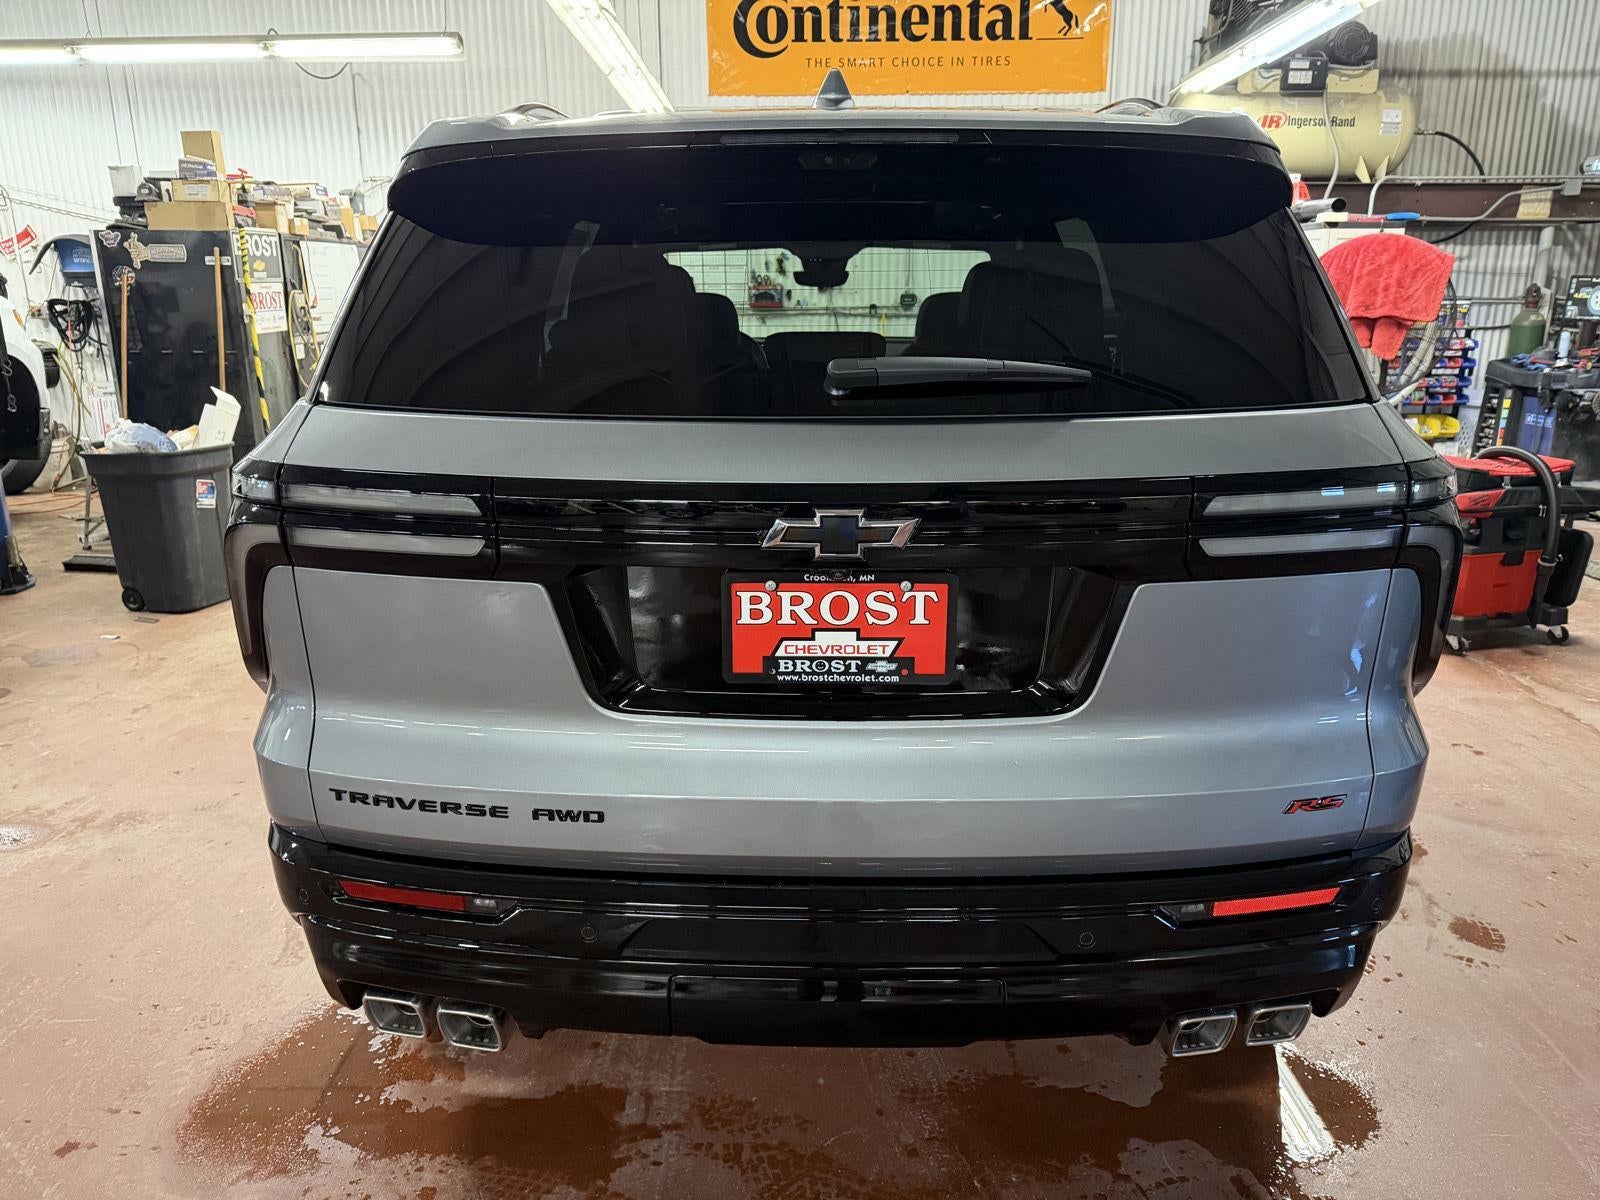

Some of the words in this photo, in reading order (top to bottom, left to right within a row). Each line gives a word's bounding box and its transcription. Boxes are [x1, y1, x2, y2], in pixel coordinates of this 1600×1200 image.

[733, 0, 1033, 58] Continental
[806, 57, 832, 69] THE
[838, 57, 885, 68] SMART
[891, 56, 944, 68] CHOICE
[951, 56, 965, 67] IN
[972, 55, 1011, 67] TIRES
[251, 291, 283, 310] BROST
[859, 574, 876, 582] MN
[735, 590, 939, 626] BROST
[784, 644, 890, 655] CHEVROLET
[778, 659, 862, 673] BROST
[777, 673, 900, 683] www.brostchevrolet.com
[329, 788, 509, 819] TRAVERSE
[531, 808, 605, 823] AWD
[1282, 794, 1347, 814] RS
